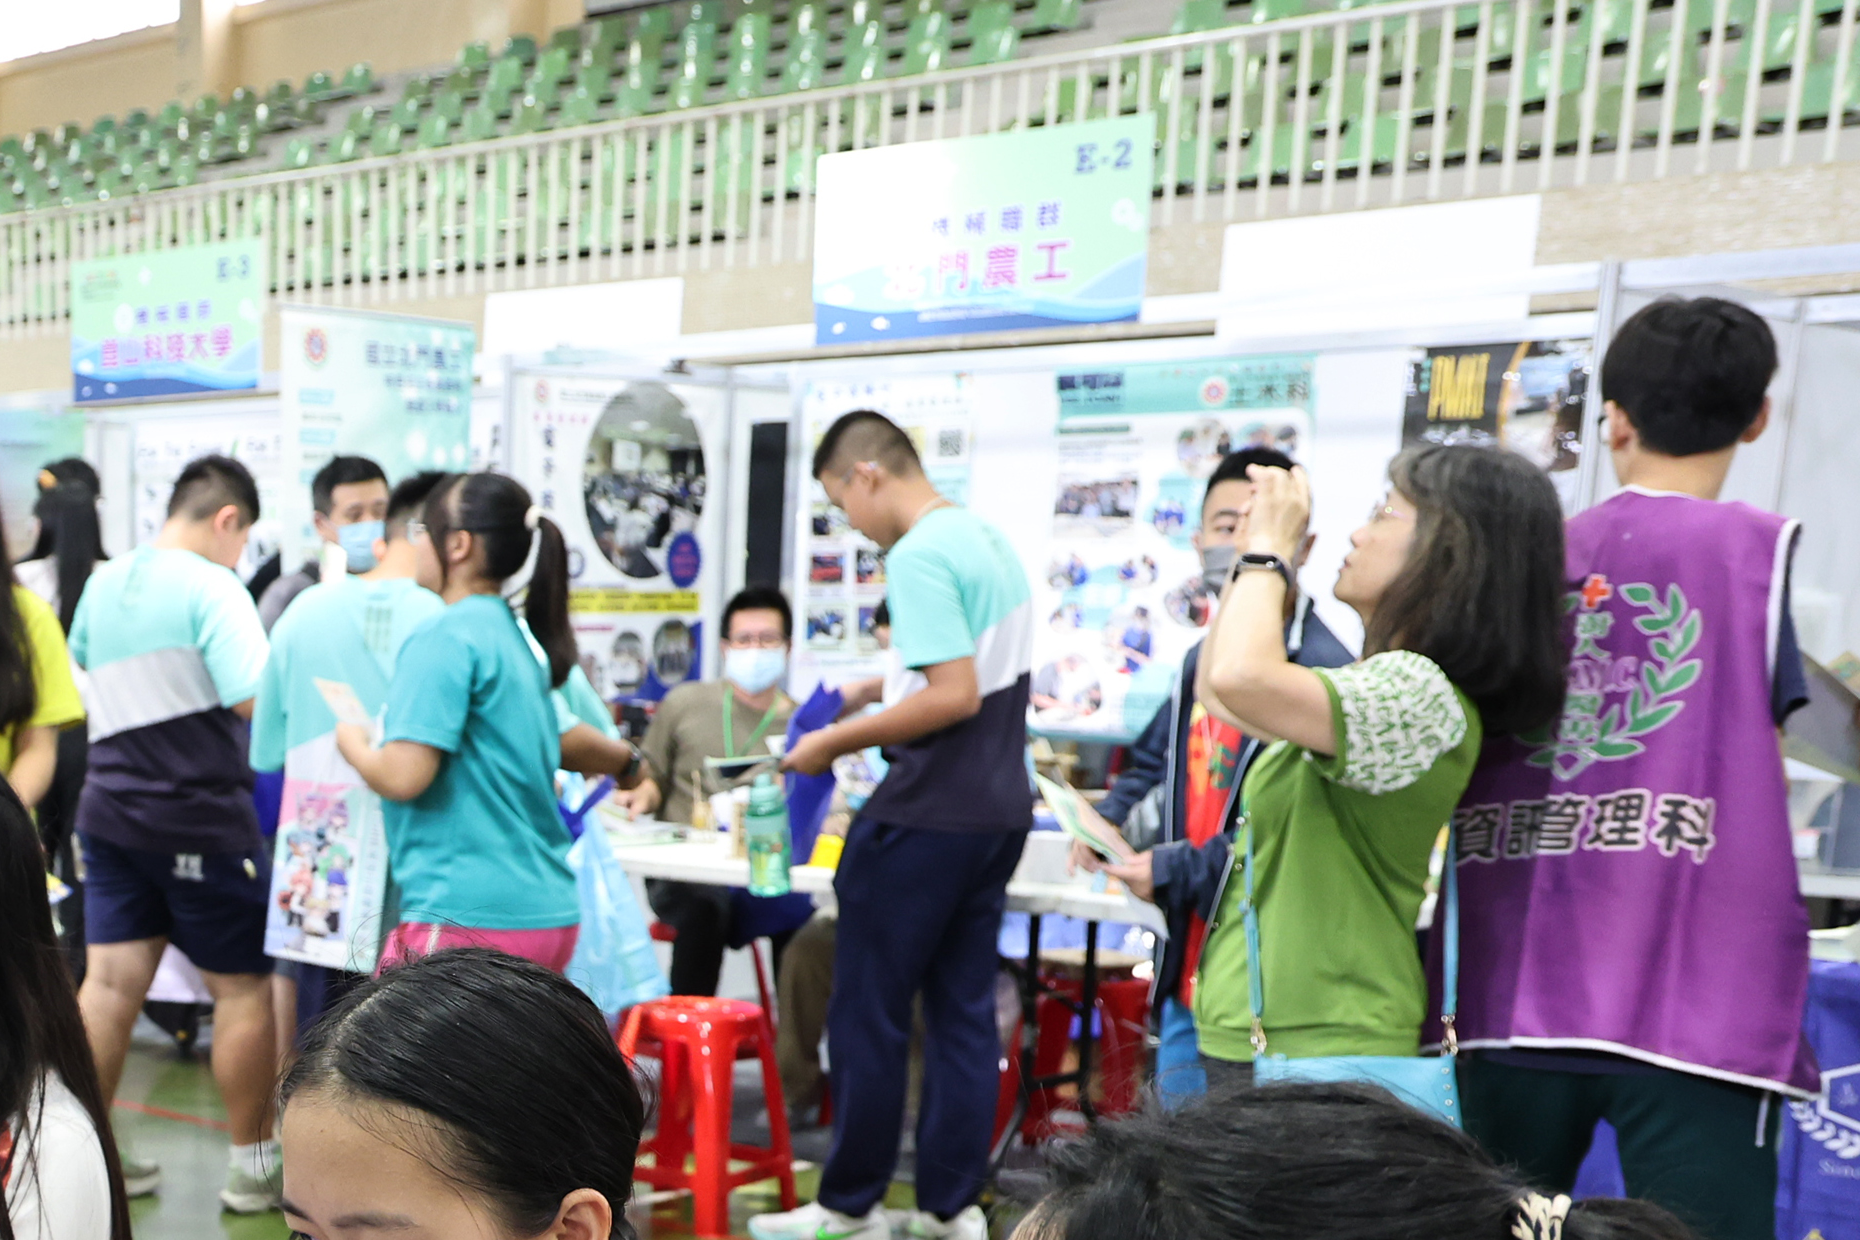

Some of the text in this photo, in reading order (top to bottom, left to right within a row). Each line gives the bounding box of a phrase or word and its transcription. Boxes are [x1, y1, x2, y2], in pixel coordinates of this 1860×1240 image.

[1075, 138, 1133, 173] E-2
[894, 241, 1069, 291] 門農工
[1454, 791, 1715, 864] 資訊管理科
